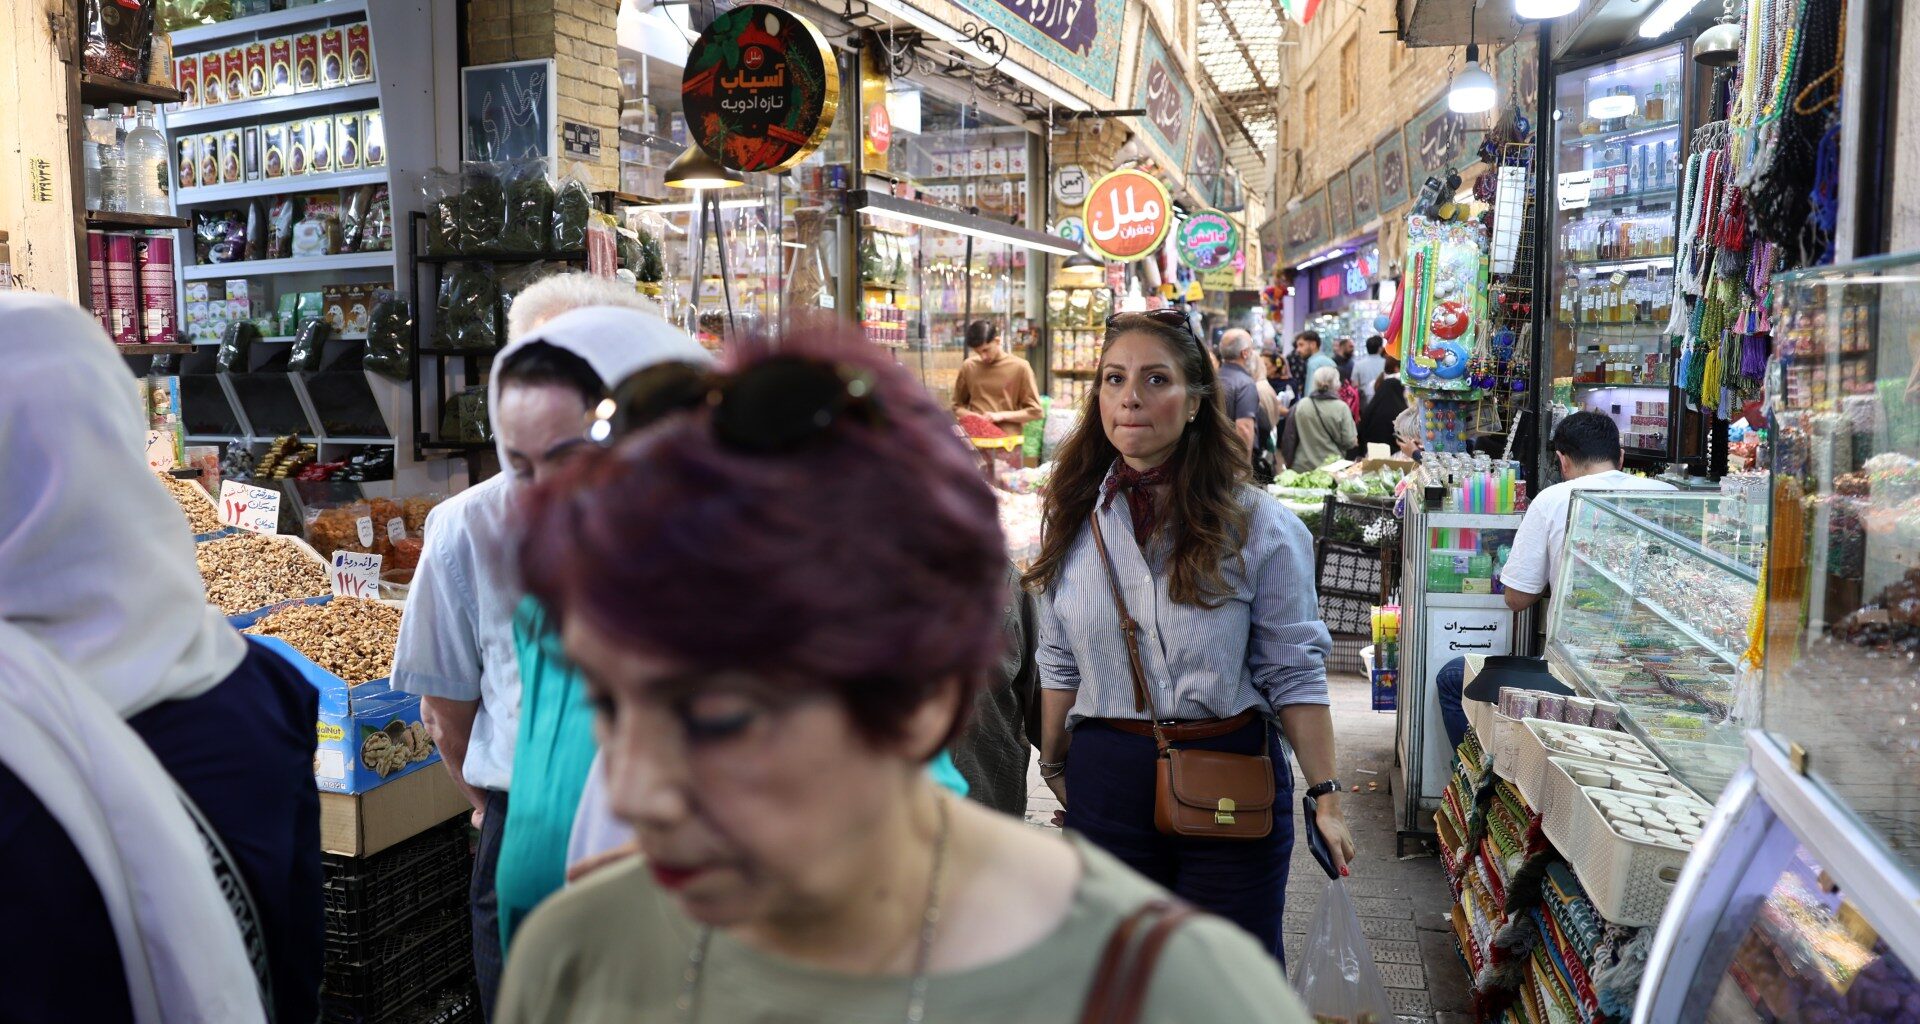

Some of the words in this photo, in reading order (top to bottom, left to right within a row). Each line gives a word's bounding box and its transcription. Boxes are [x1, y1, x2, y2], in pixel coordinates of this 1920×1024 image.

[720, 63, 785, 94] آسیاب
[721, 96, 757, 113] ادویه
[760, 96, 783, 113] تازه
[1092, 185, 1160, 241] ملل
[1120, 223, 1155, 239] زعفران
[1444, 621, 1497, 633] تعمیرات
[1449, 639, 1492, 651] تسبیح
